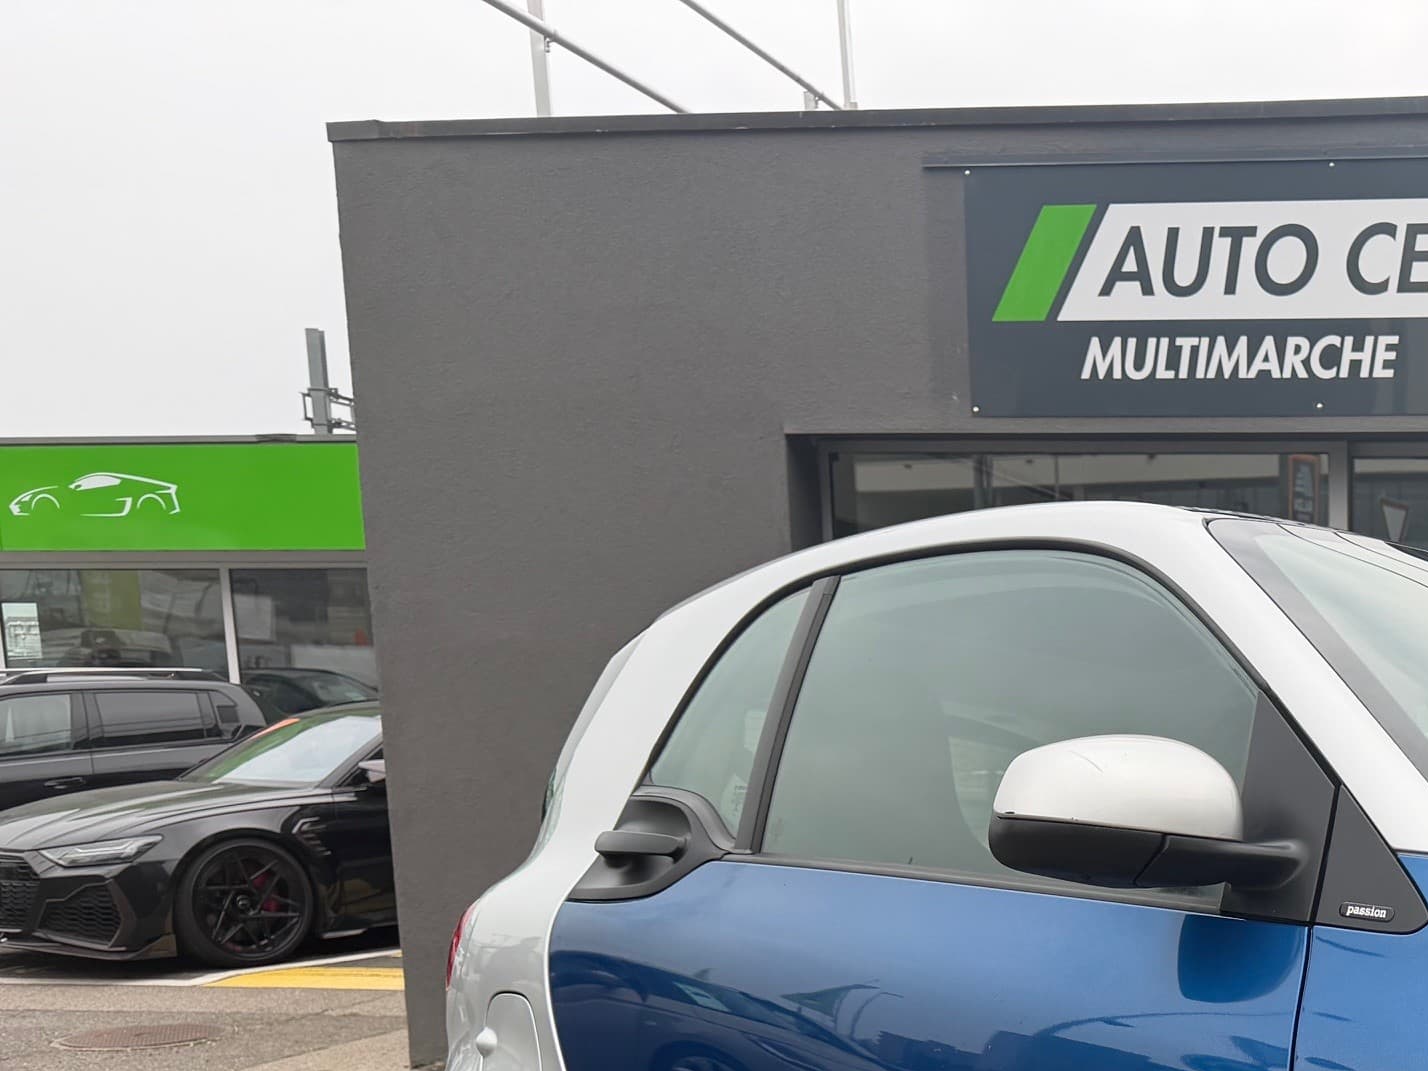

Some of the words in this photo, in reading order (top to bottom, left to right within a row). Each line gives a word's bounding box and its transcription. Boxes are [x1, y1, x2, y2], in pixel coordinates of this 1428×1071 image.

[1099, 222, 1320, 298] AUTO
[1080, 334, 1400, 381] MULTIMARCHE
[1345, 904, 1387, 918] passion
